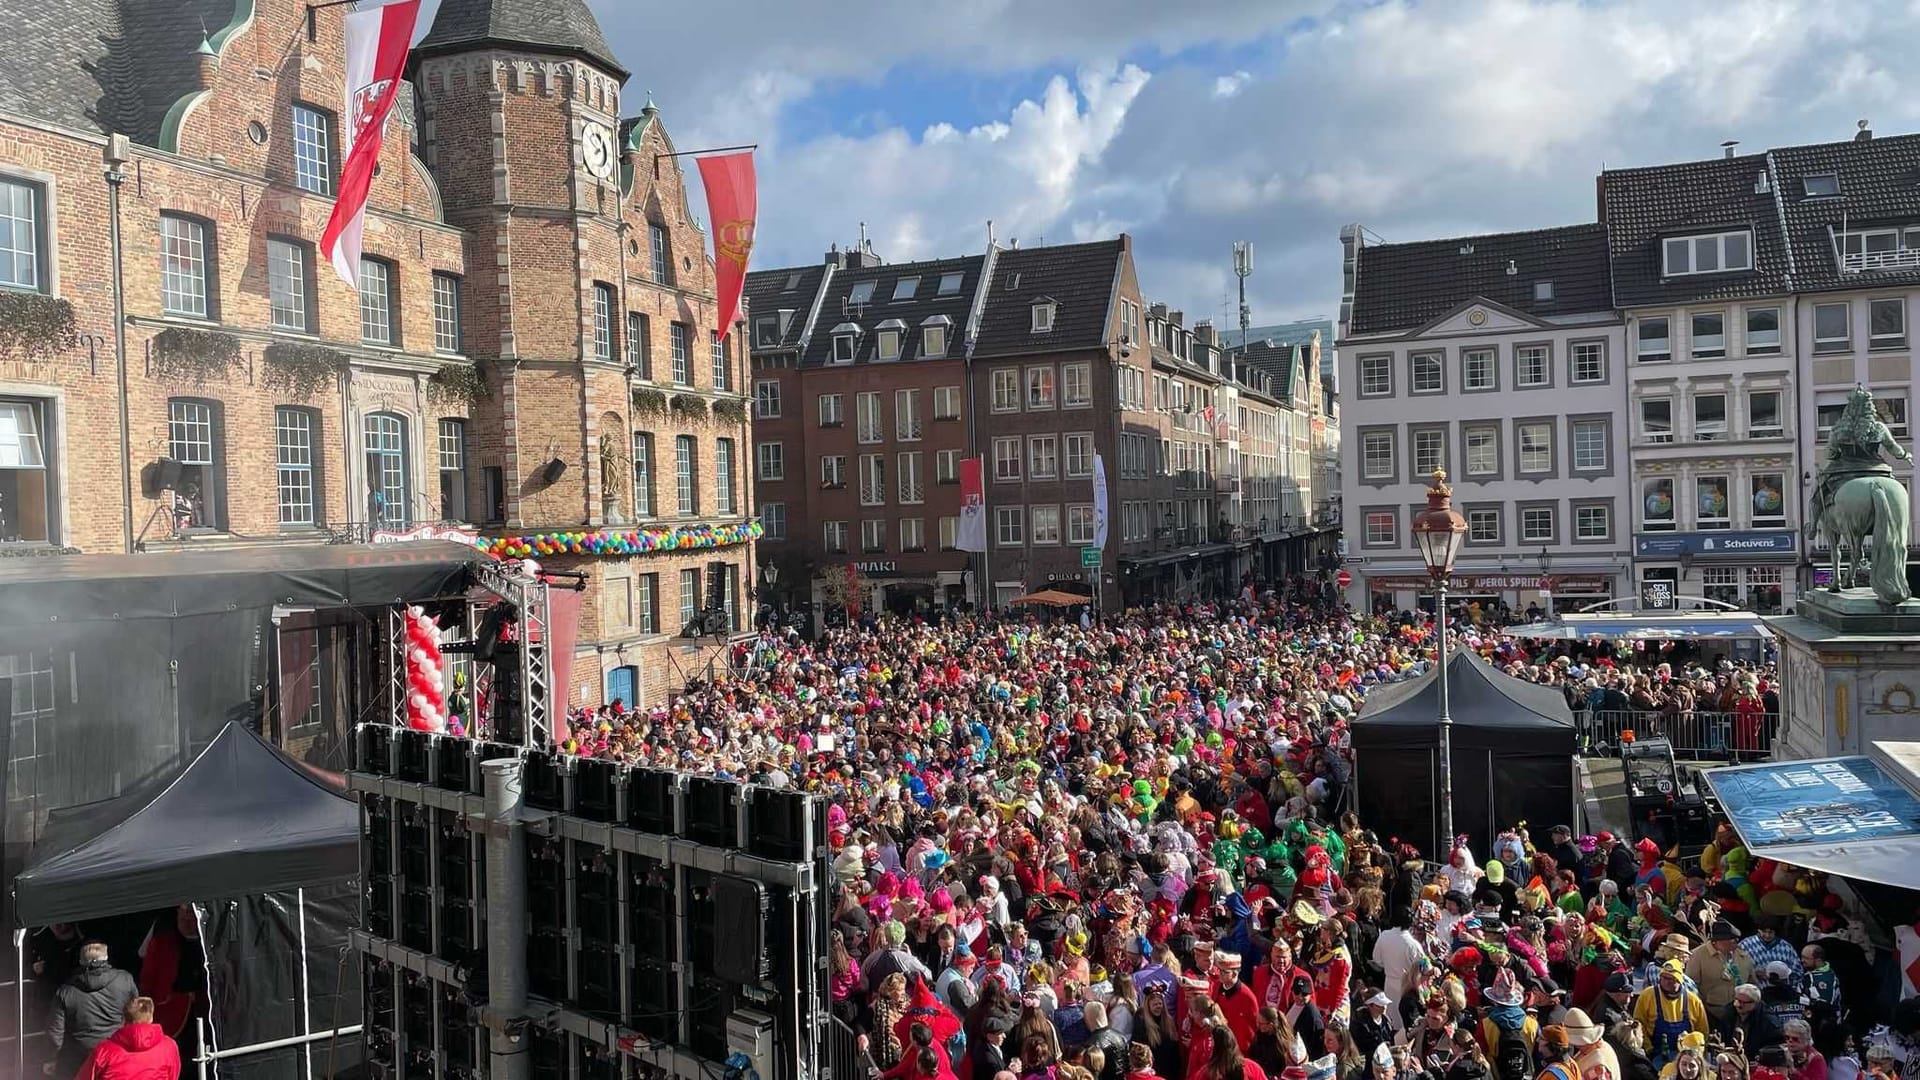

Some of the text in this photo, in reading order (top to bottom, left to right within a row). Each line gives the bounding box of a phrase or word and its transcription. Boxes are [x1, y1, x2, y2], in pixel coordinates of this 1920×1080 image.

[1724, 538, 1775, 549] Scheuvens
[853, 561, 896, 572] MAKI
[1450, 576, 1541, 588] PILS APEROL SPRITZ
[1653, 583, 1667, 591] SCH
[1653, 599, 1663, 607] ER
[1660, 781, 1670, 792] 20
